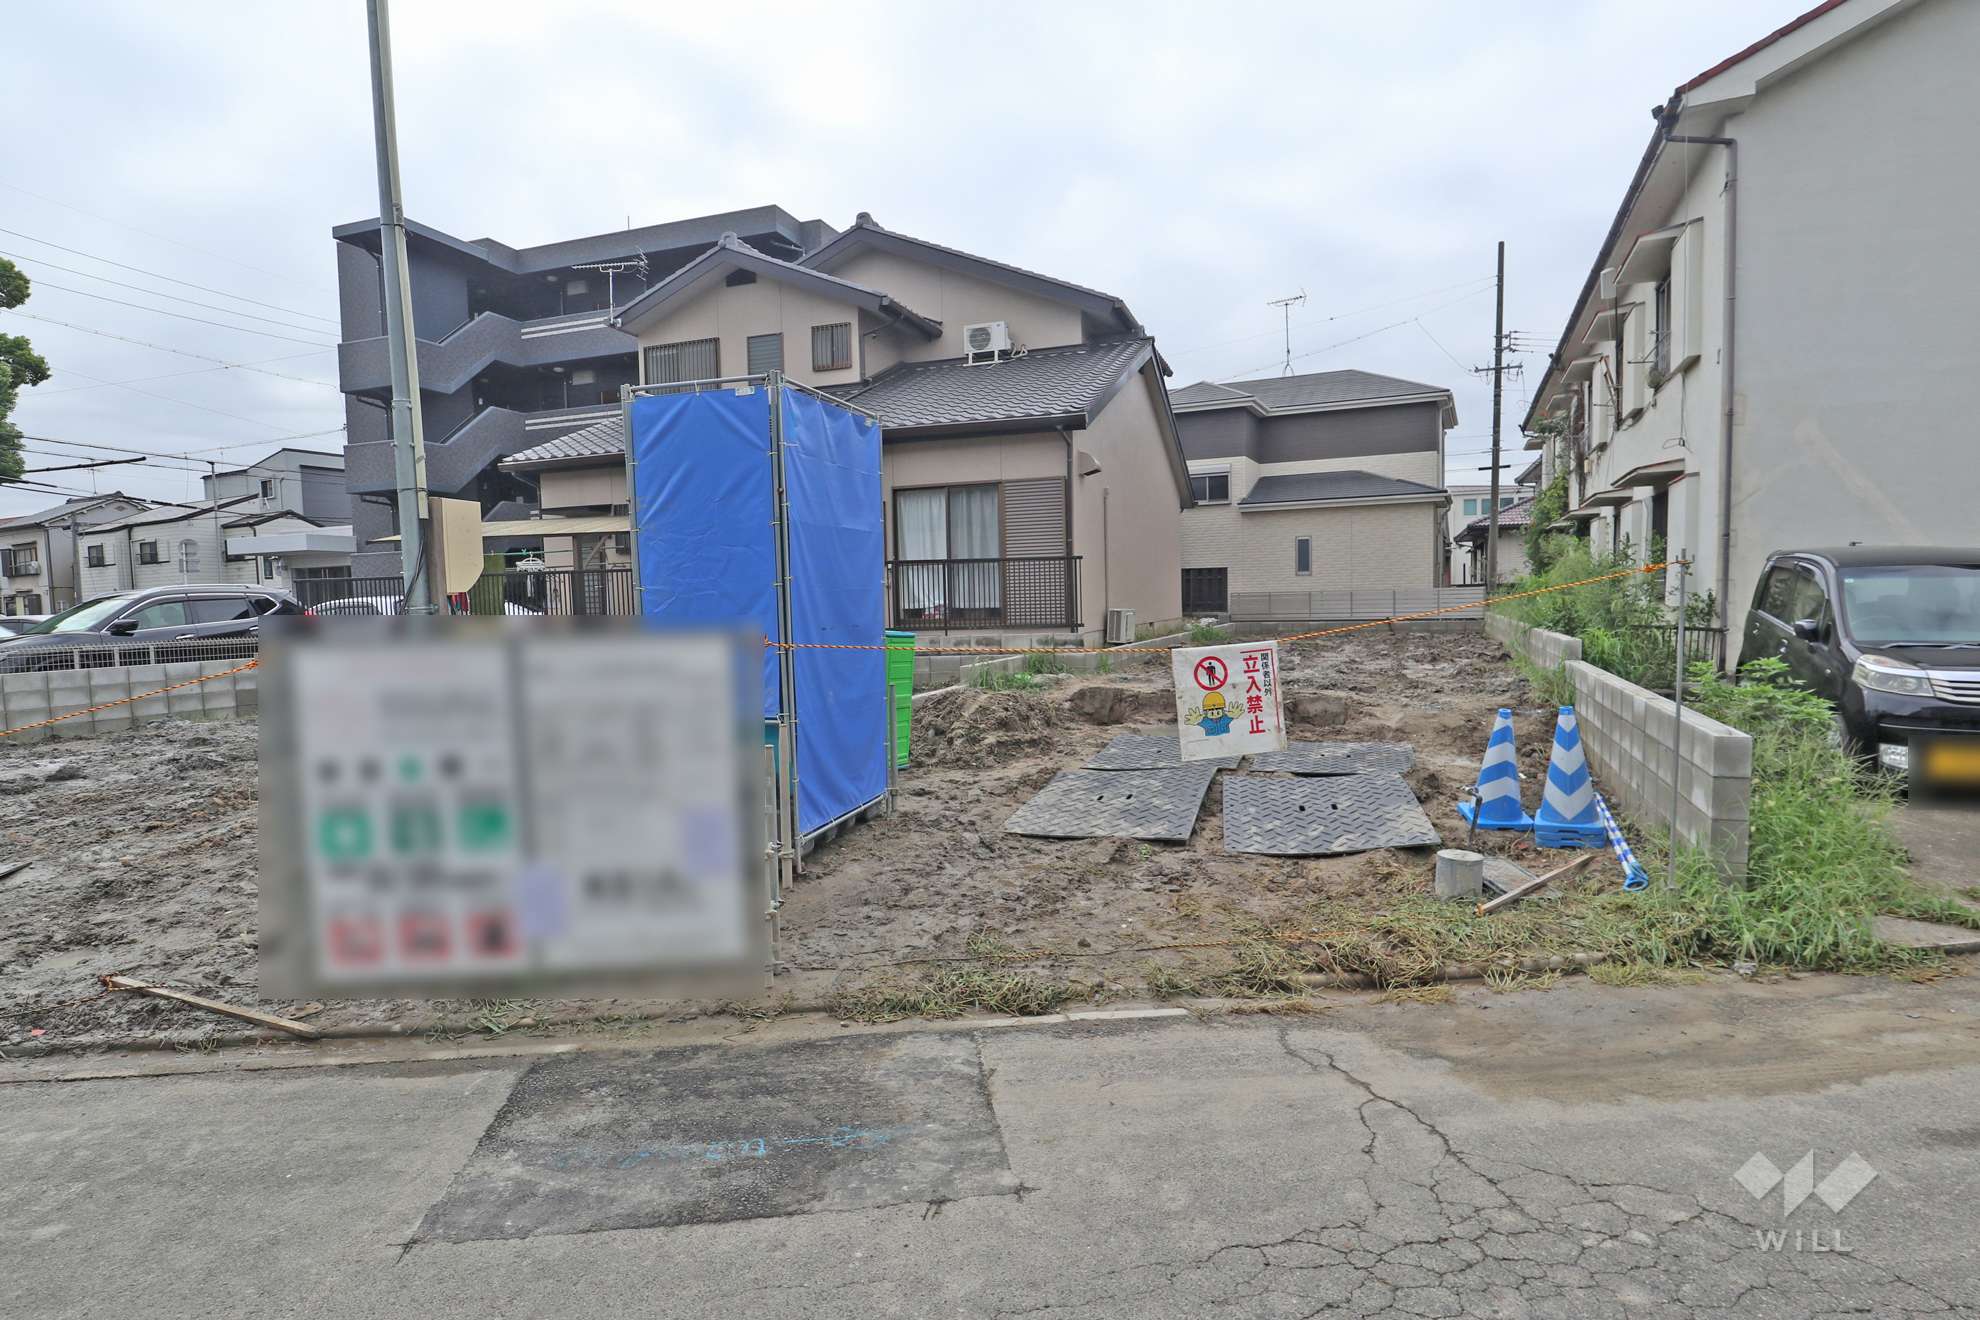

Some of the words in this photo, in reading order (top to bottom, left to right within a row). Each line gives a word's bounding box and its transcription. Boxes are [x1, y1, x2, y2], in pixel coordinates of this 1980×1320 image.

[1242, 655, 1266, 735] 立入禁止
[1260, 652, 1273, 697] 関係者以外
